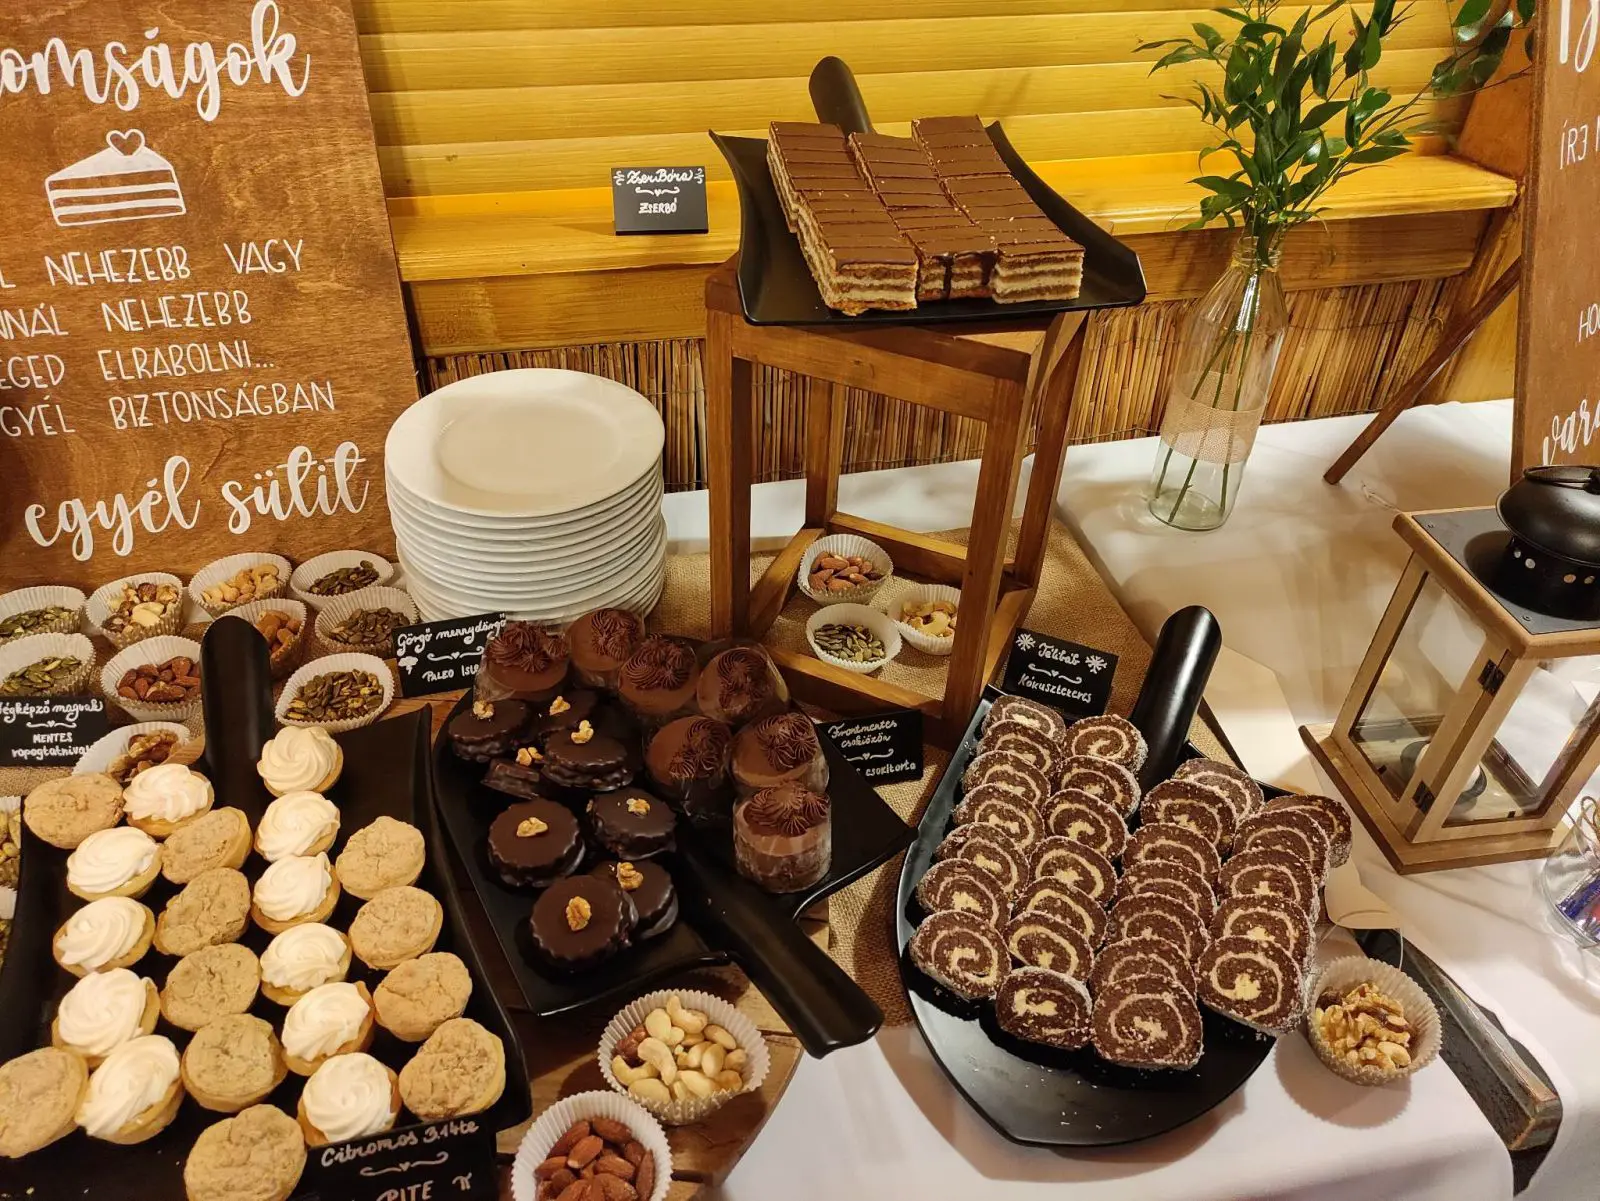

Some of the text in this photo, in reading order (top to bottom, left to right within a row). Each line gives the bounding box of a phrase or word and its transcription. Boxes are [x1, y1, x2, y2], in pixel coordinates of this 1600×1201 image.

[44, 246, 191, 286] NEHEZEBB
[223, 239, 303, 274] VAGY
[101, 290, 252, 332] NEHEZEBB
[98, 340, 275, 381] ELRABOLNI...
[0, 381, 335, 437] GYÉL BIZTONSÁGBAN
[24, 441, 370, 562] egyél sütit
[52, 698, 104, 722] magvak
[11, 744, 91, 761] ropogtatnival
[32, 732, 73, 743] MENTES
[321, 1130, 418, 1168] Citromos
[376, 1180, 434, 1201] PITE
